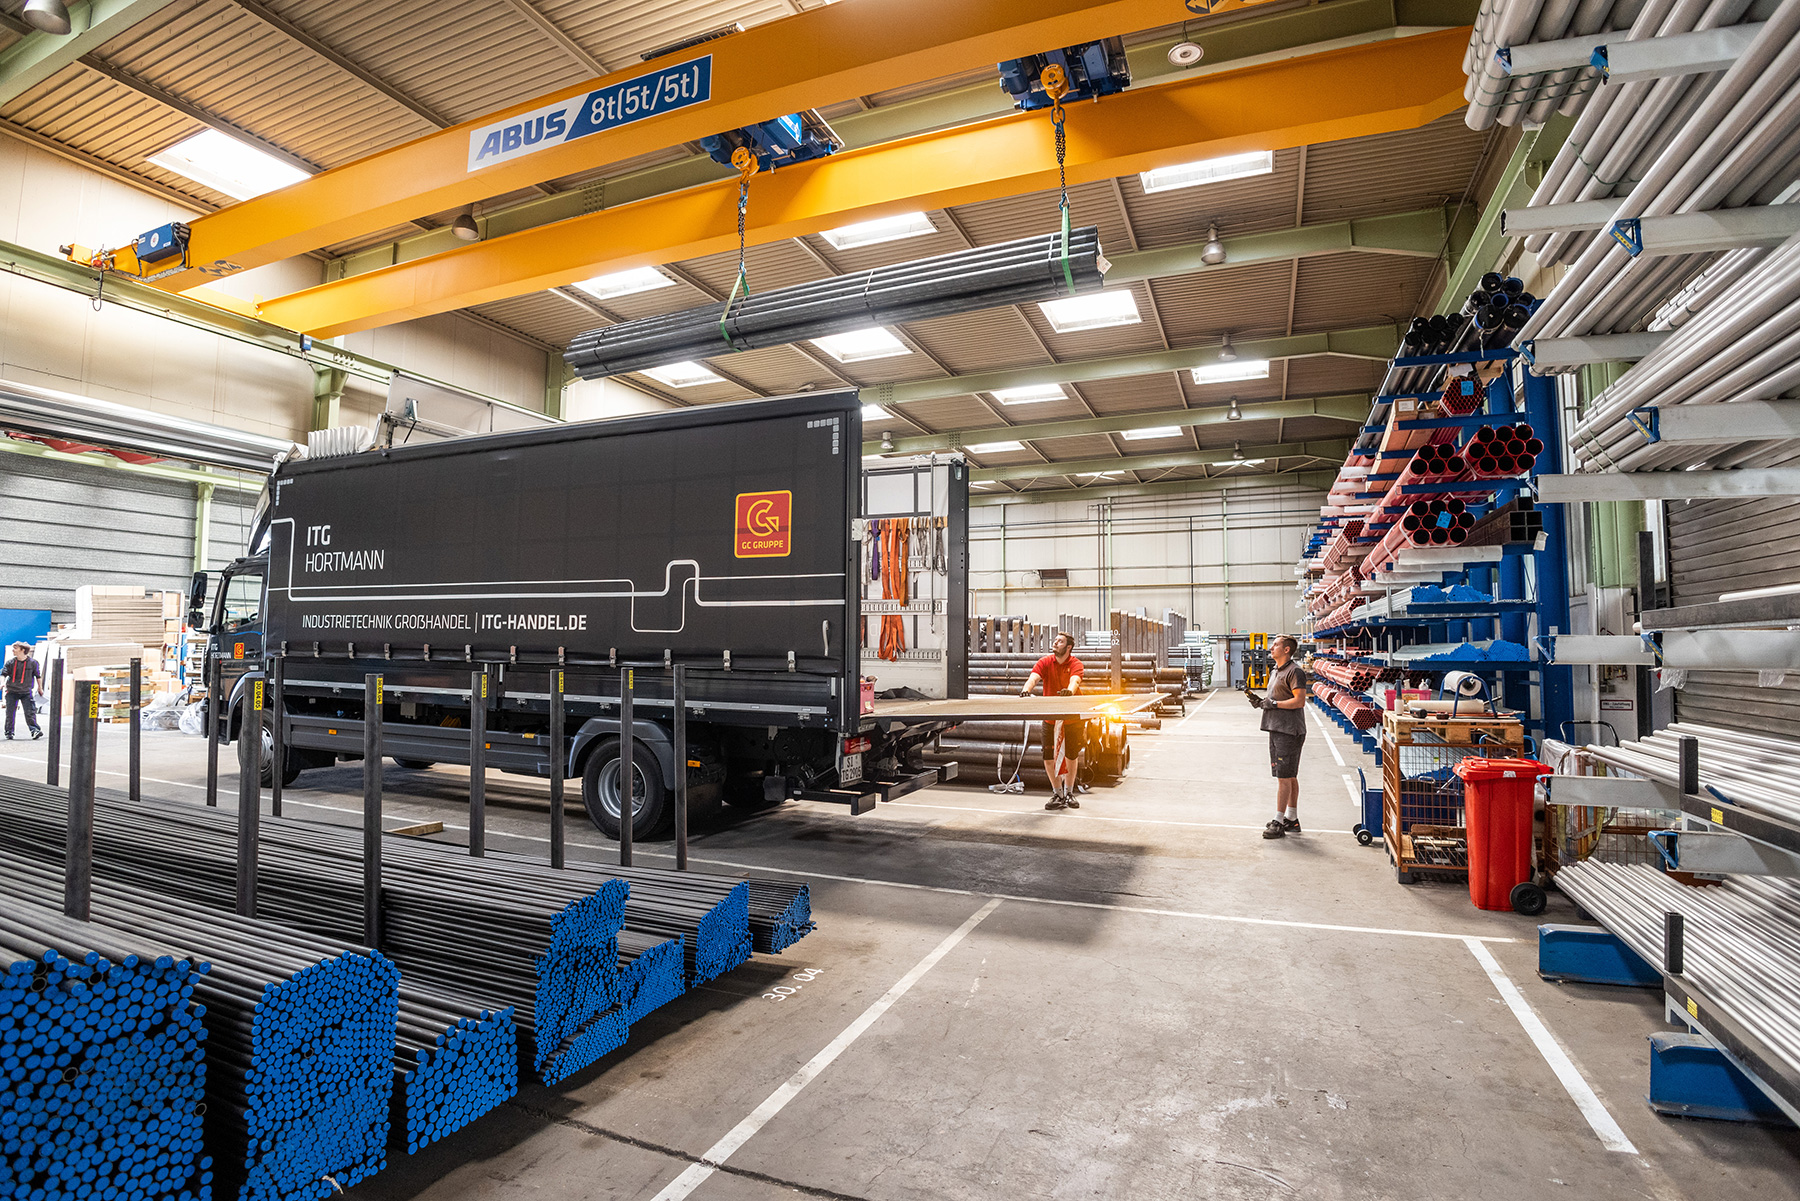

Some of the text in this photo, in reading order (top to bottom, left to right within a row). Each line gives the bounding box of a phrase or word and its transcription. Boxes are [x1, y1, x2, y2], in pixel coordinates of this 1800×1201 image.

[475, 64, 699, 161] ABUS 8t(5t/5t)
[306, 524, 331, 546] ITG
[741, 540, 784, 550] GC GRUPPE
[305, 549, 385, 573] HORTMANN
[302, 614, 393, 629] INDUSTRIETECHNIK
[481, 614, 587, 631] ITG-HANDEL.DE
[1111, 638, 1120, 646] 02
[846, 756, 854, 768] SI
